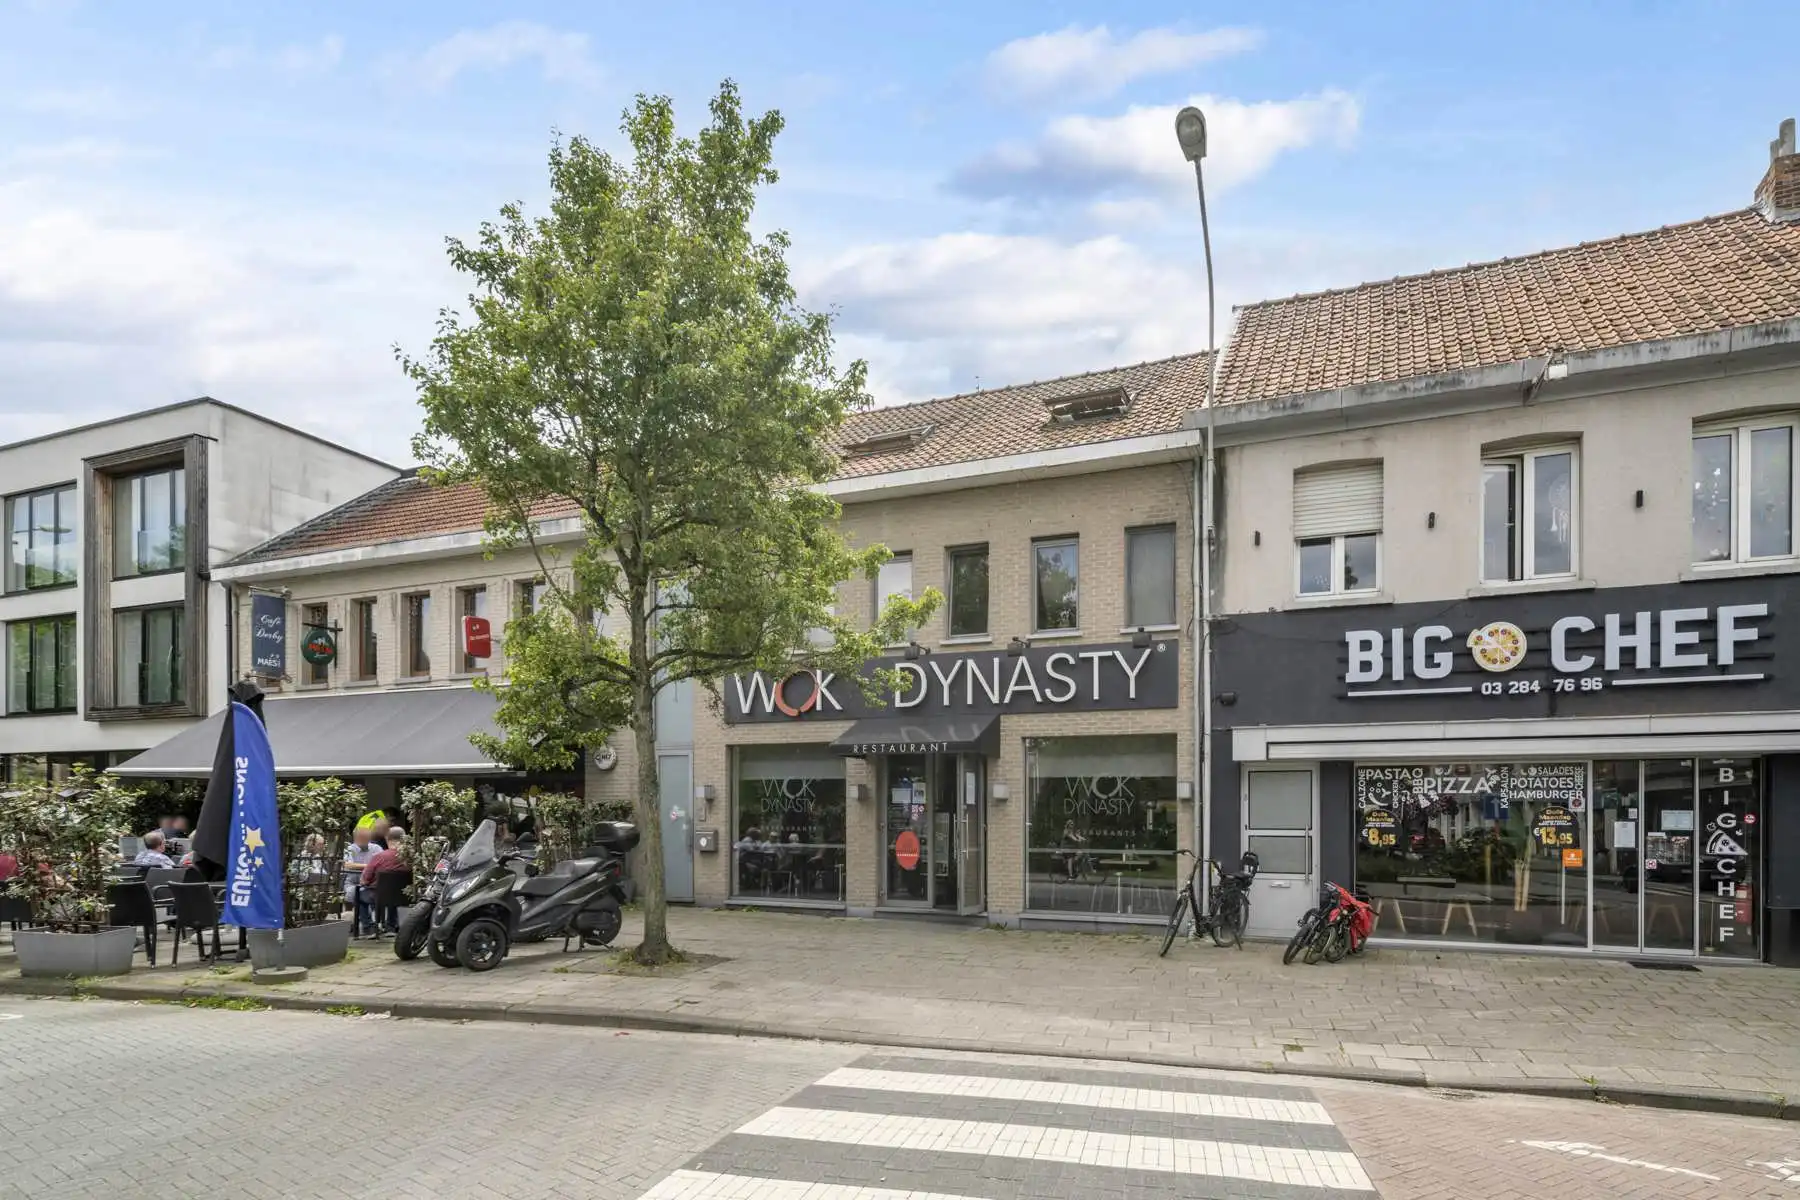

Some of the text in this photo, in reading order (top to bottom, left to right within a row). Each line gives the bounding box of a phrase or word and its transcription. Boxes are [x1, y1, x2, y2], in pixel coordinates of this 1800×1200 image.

[1345, 603, 1768, 683] BIG CHEF
[733, 667, 844, 717] WOK
[1481, 676, 1603, 695] 03 284 76 96
[853, 742, 948, 754] RESTAURANT
[1365, 768, 1412, 780] PASTA
[1412, 767, 1424, 794] BBQ
[1537, 766, 1574, 776] SALADES
[761, 775, 816, 800] WOK
[1064, 773, 1136, 800] WOK
[1358, 769, 1366, 809] CALZONE
[1423, 776, 1493, 794] PIZZA
[1500, 766, 1509, 809] KAPSALON
[1510, 776, 1574, 789] POTATOES
[761, 798, 817, 813] DYNASTY
[1509, 789, 1583, 800] HAMBURGER
[1716, 767, 1737, 829] BIG
[1063, 798, 1135, 815] DYNASTY
[1716, 858, 1737, 942] CHEF
